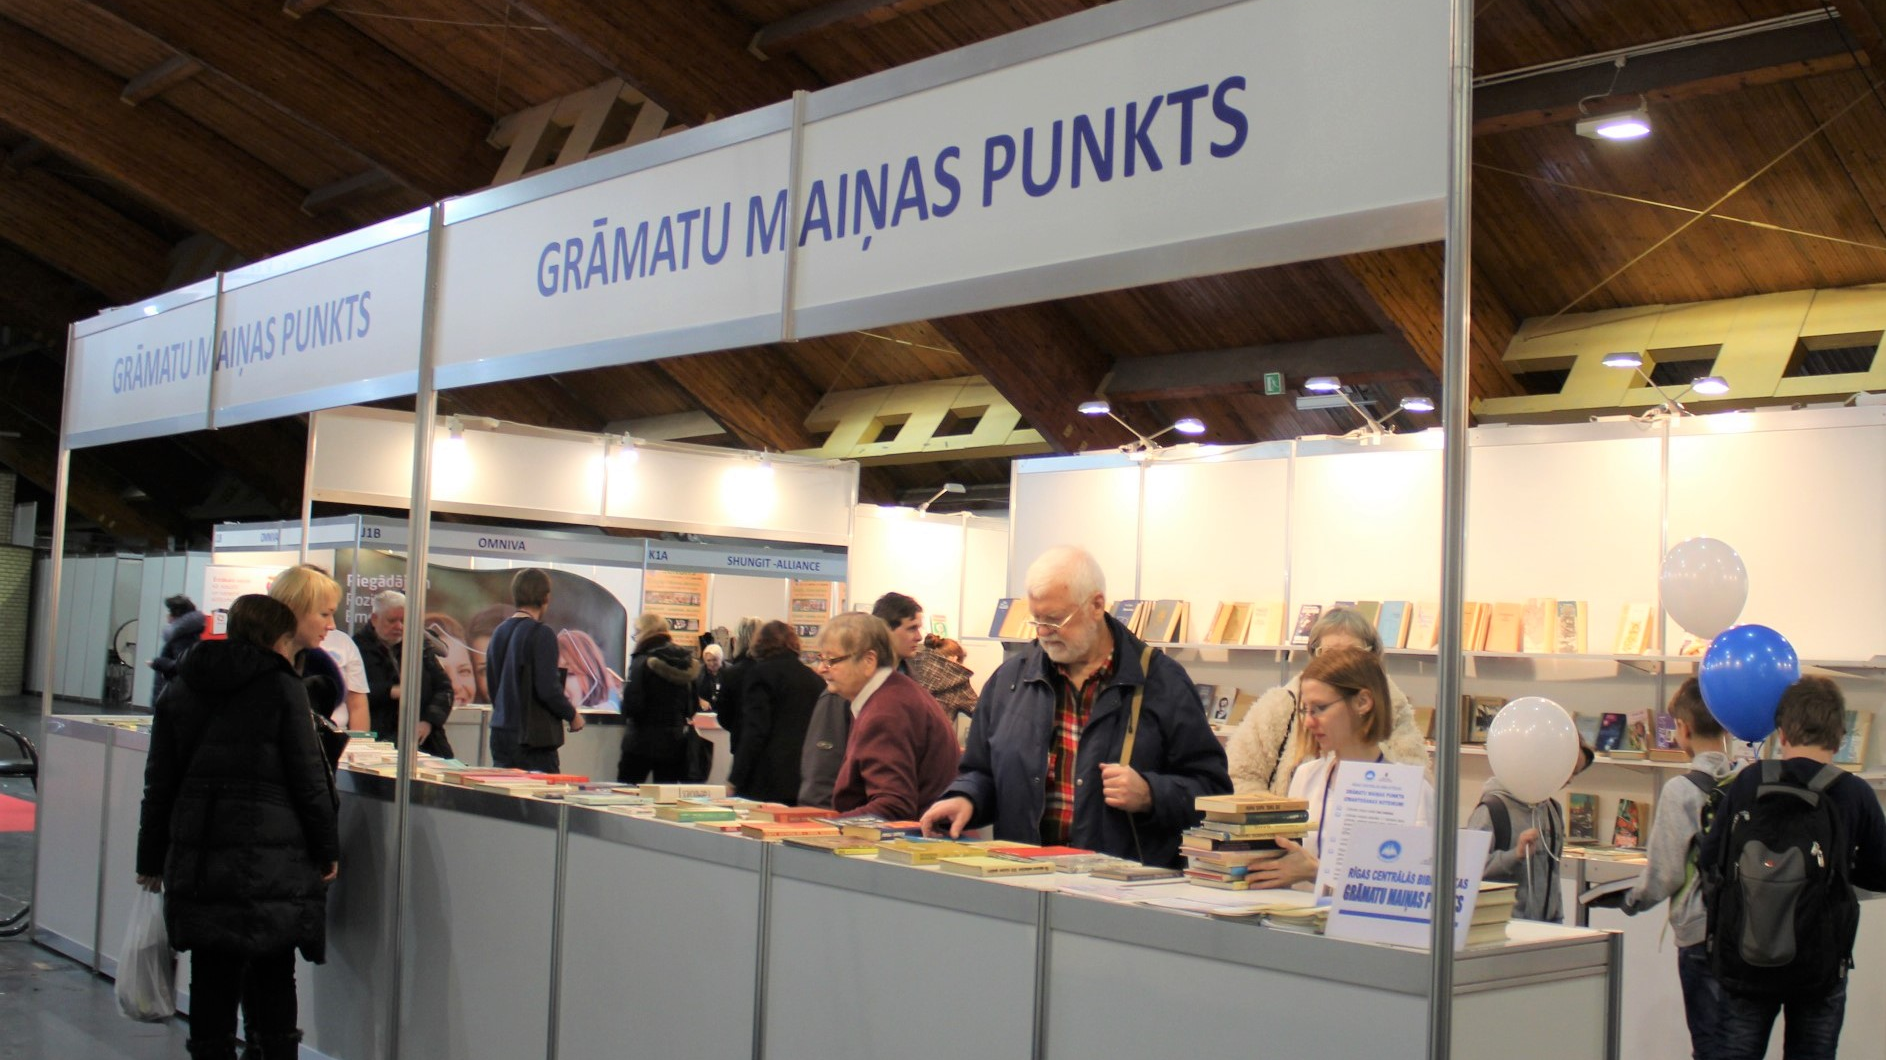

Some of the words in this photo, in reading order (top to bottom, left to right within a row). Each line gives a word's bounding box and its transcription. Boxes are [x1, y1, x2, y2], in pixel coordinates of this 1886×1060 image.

[537, 202, 731, 297] GRĀMATU
[746, 146, 961, 256] MAIŅAS
[982, 76, 1248, 207] PUNKTS
[113, 341, 191, 393] GRĀMATU
[197, 318, 276, 375] MAIŅAS
[282, 291, 371, 355] PUNKTS
[478, 537, 526, 550] OMNIVA
[648, 550, 668, 561] K1A
[727, 556, 771, 569] SHUNGIT
[1343, 882, 1388, 905] GRĀMATU
